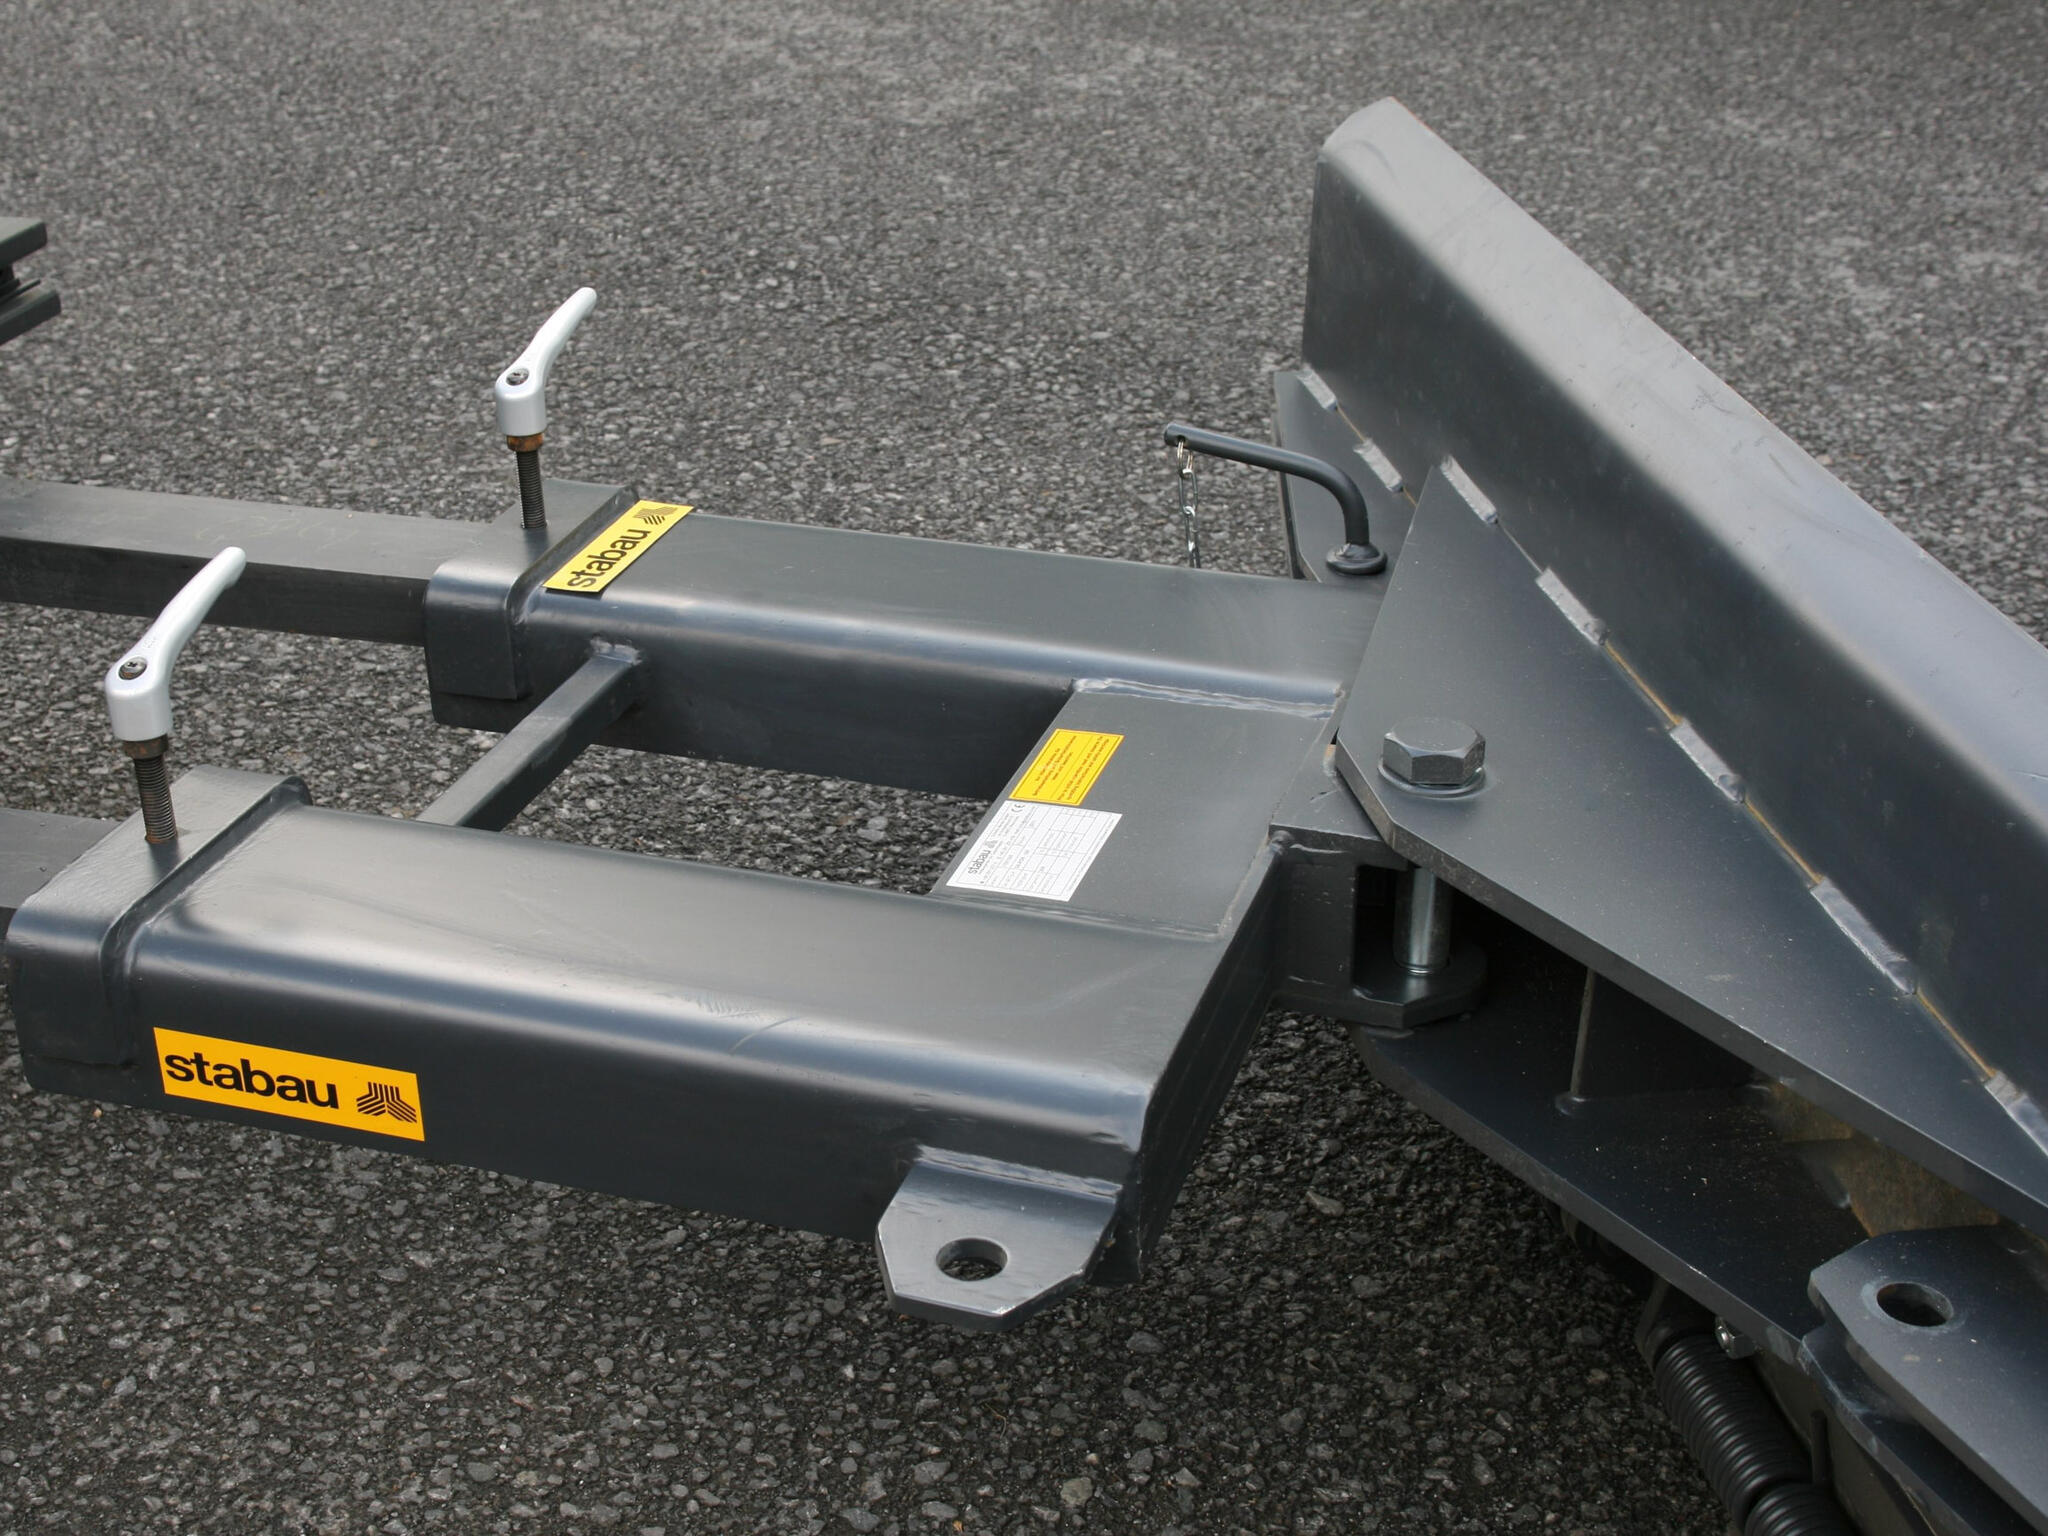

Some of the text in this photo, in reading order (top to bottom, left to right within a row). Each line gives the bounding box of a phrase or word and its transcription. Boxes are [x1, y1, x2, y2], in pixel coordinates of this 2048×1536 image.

[567, 529, 652, 588] stabau
[967, 849, 991, 875] stabau
[164, 1052, 339, 1109] stabau
